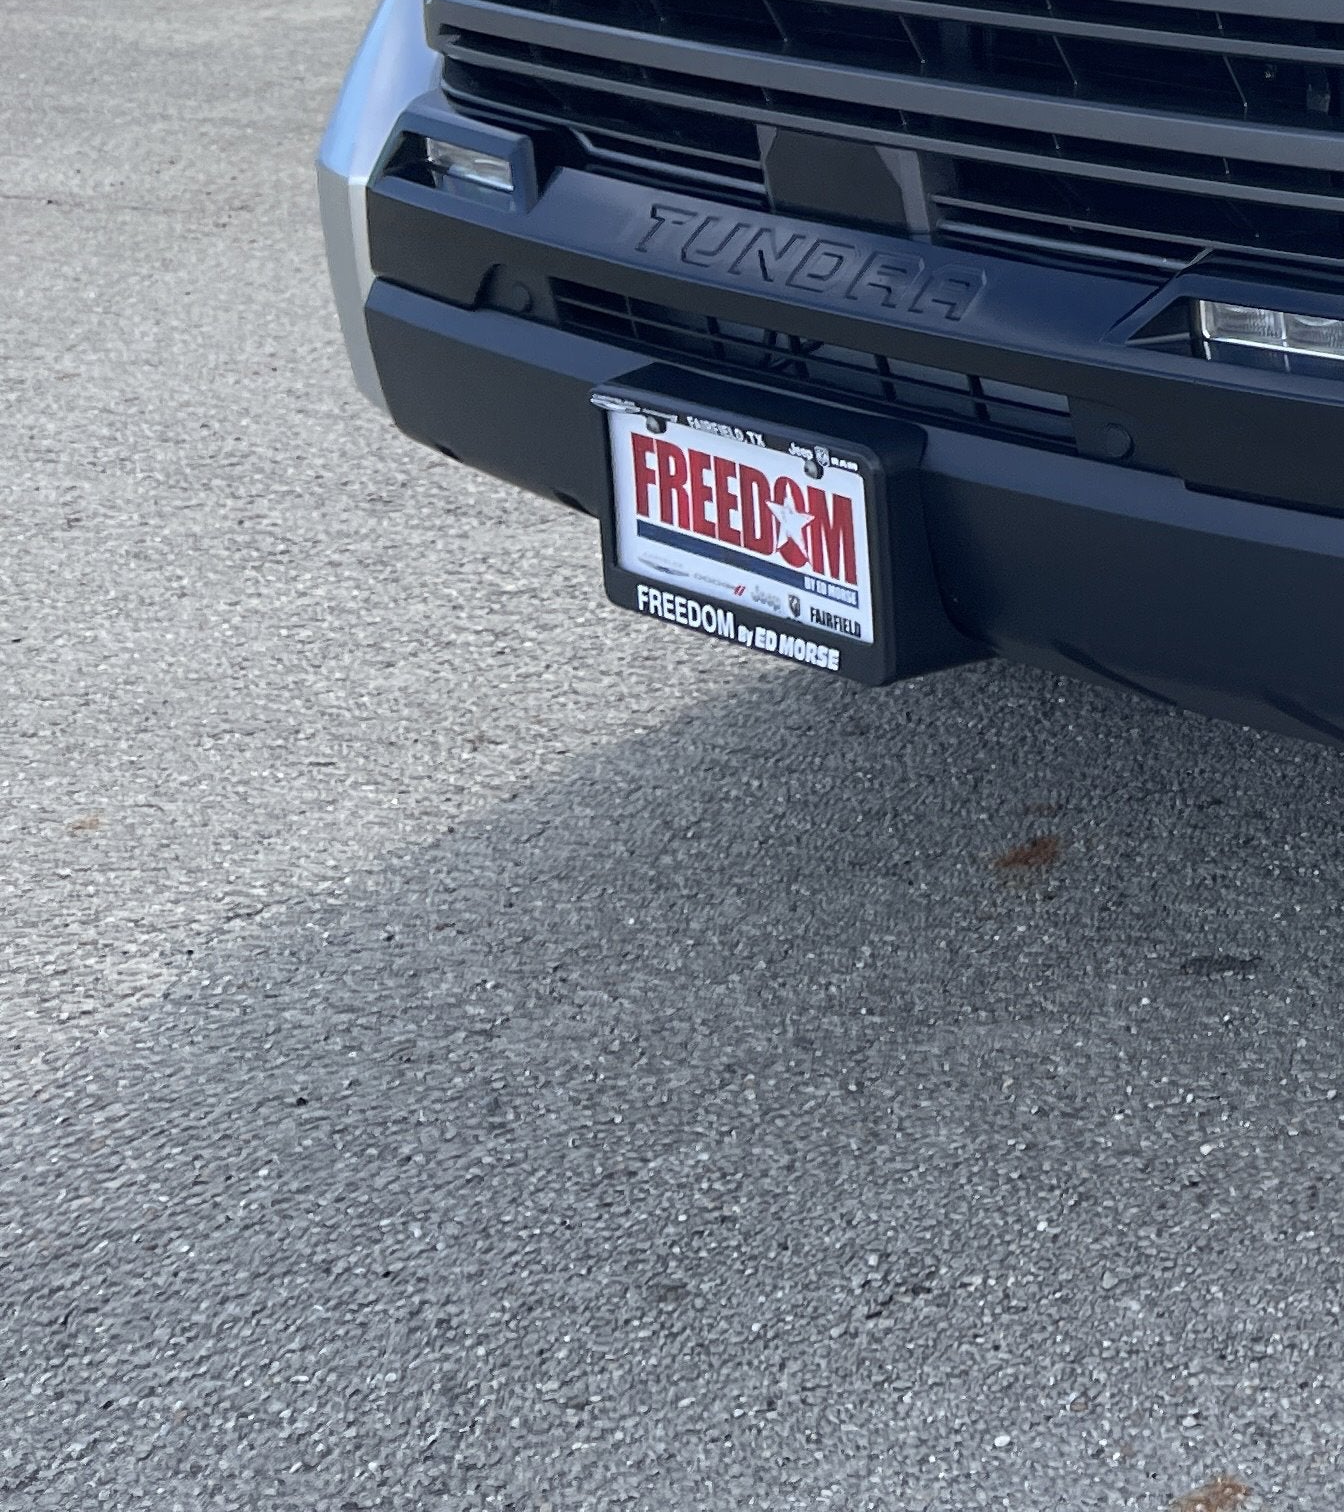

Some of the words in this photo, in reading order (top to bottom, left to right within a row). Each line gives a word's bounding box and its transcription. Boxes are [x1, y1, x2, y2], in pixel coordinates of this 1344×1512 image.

[634, 203, 988, 321] TUNDRA
[631, 432, 858, 586] FREEDOM
[637, 584, 735, 639] FREEDOM
[755, 626, 778, 653] ED
[779, 633, 840, 672] MORSE
[810, 606, 862, 638] FAIRFIELD
